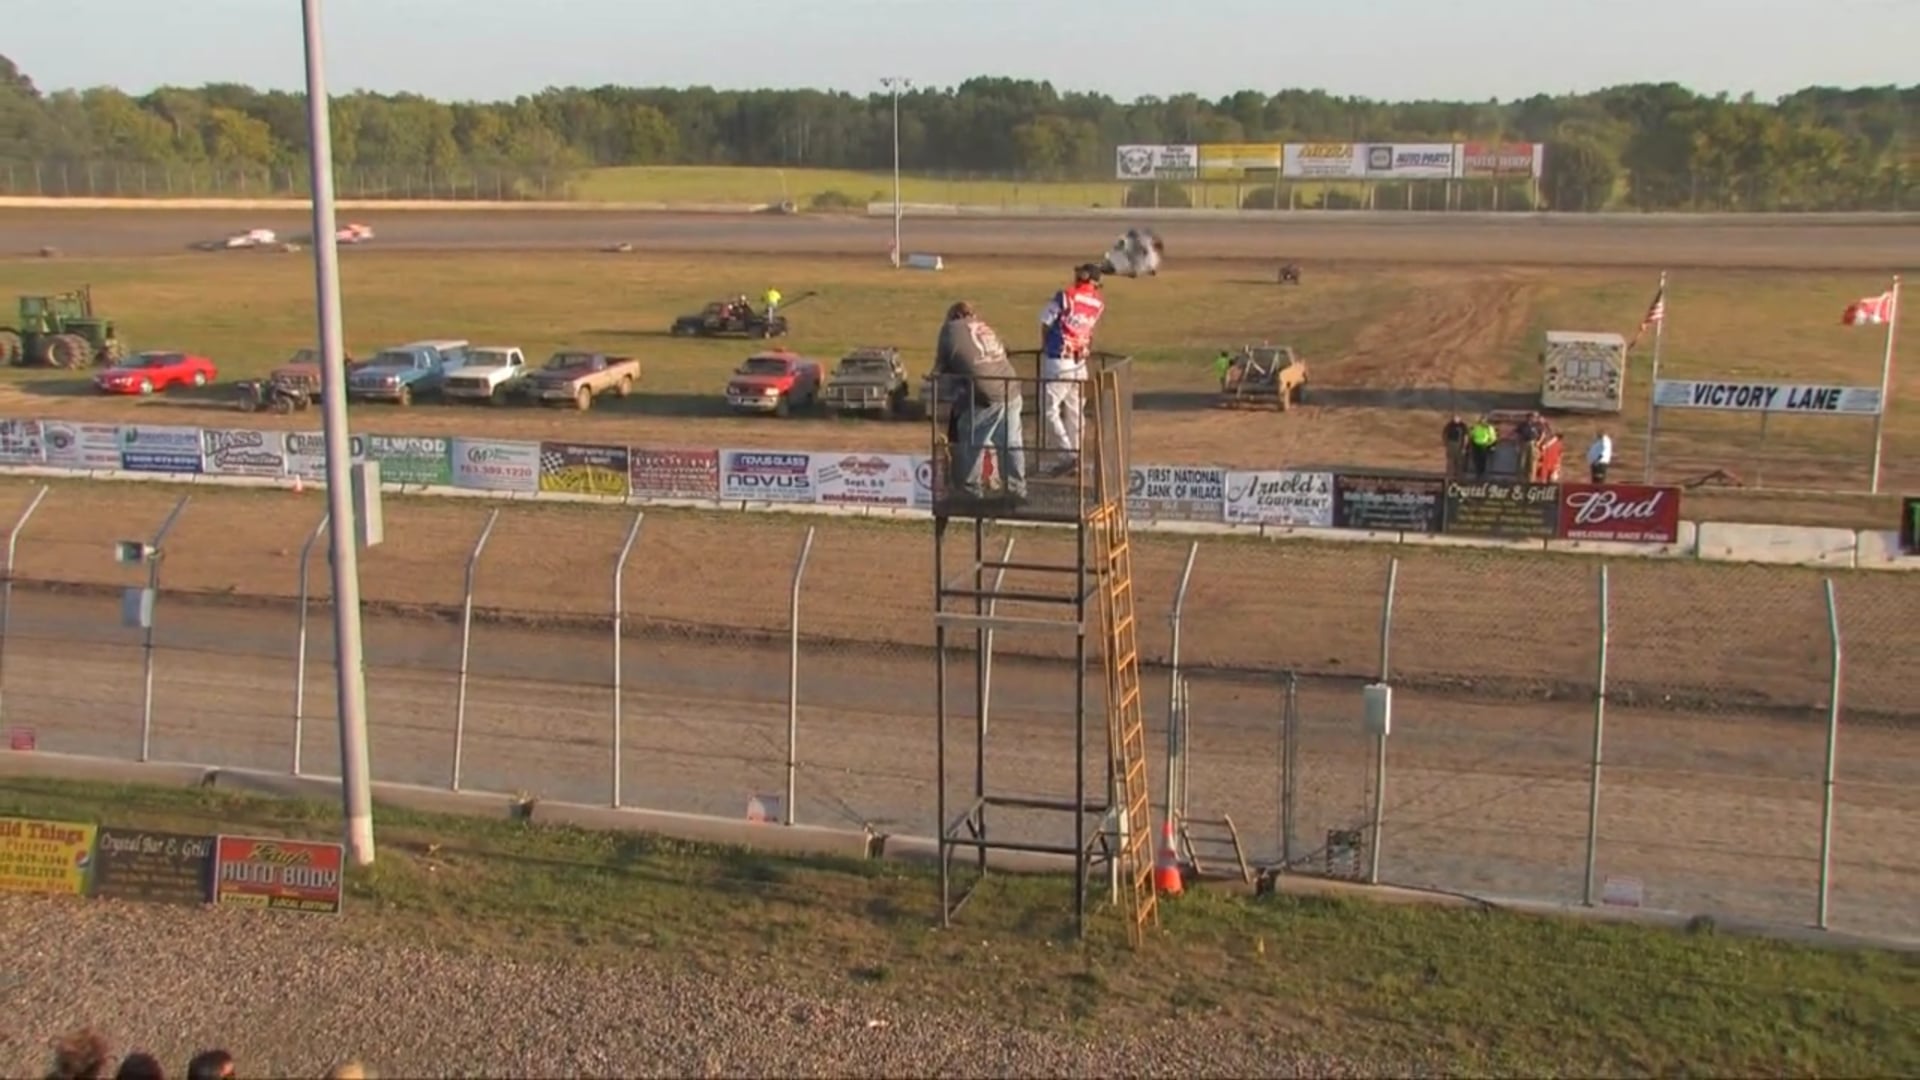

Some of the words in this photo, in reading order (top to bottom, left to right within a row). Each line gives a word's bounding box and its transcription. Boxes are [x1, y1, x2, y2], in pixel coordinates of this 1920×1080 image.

[1692, 383, 1778, 407] VICTORY
[1786, 388, 1843, 410] LANE
[1147, 468, 1172, 483] FIRST
[1174, 469, 1221, 485] NATIONAL
[1228, 473, 1329, 503] Arnold's
[1147, 484, 1171, 498] BANK
[1175, 485, 1188, 499] OF
[1190, 485, 1222, 500] MILACA
[1256, 496, 1330, 508] EQUIPMENT
[1448, 482, 1489, 503] Crystal
[1488, 485, 1510, 498] Bar
[1527, 485, 1558, 504] Grill
[1566, 490, 1664, 524] Bud
[0, 820, 21, 837] ild
[27, 822, 84, 845] Things
[223, 861, 274, 884] AUTO
[283, 866, 337, 888] BODY
